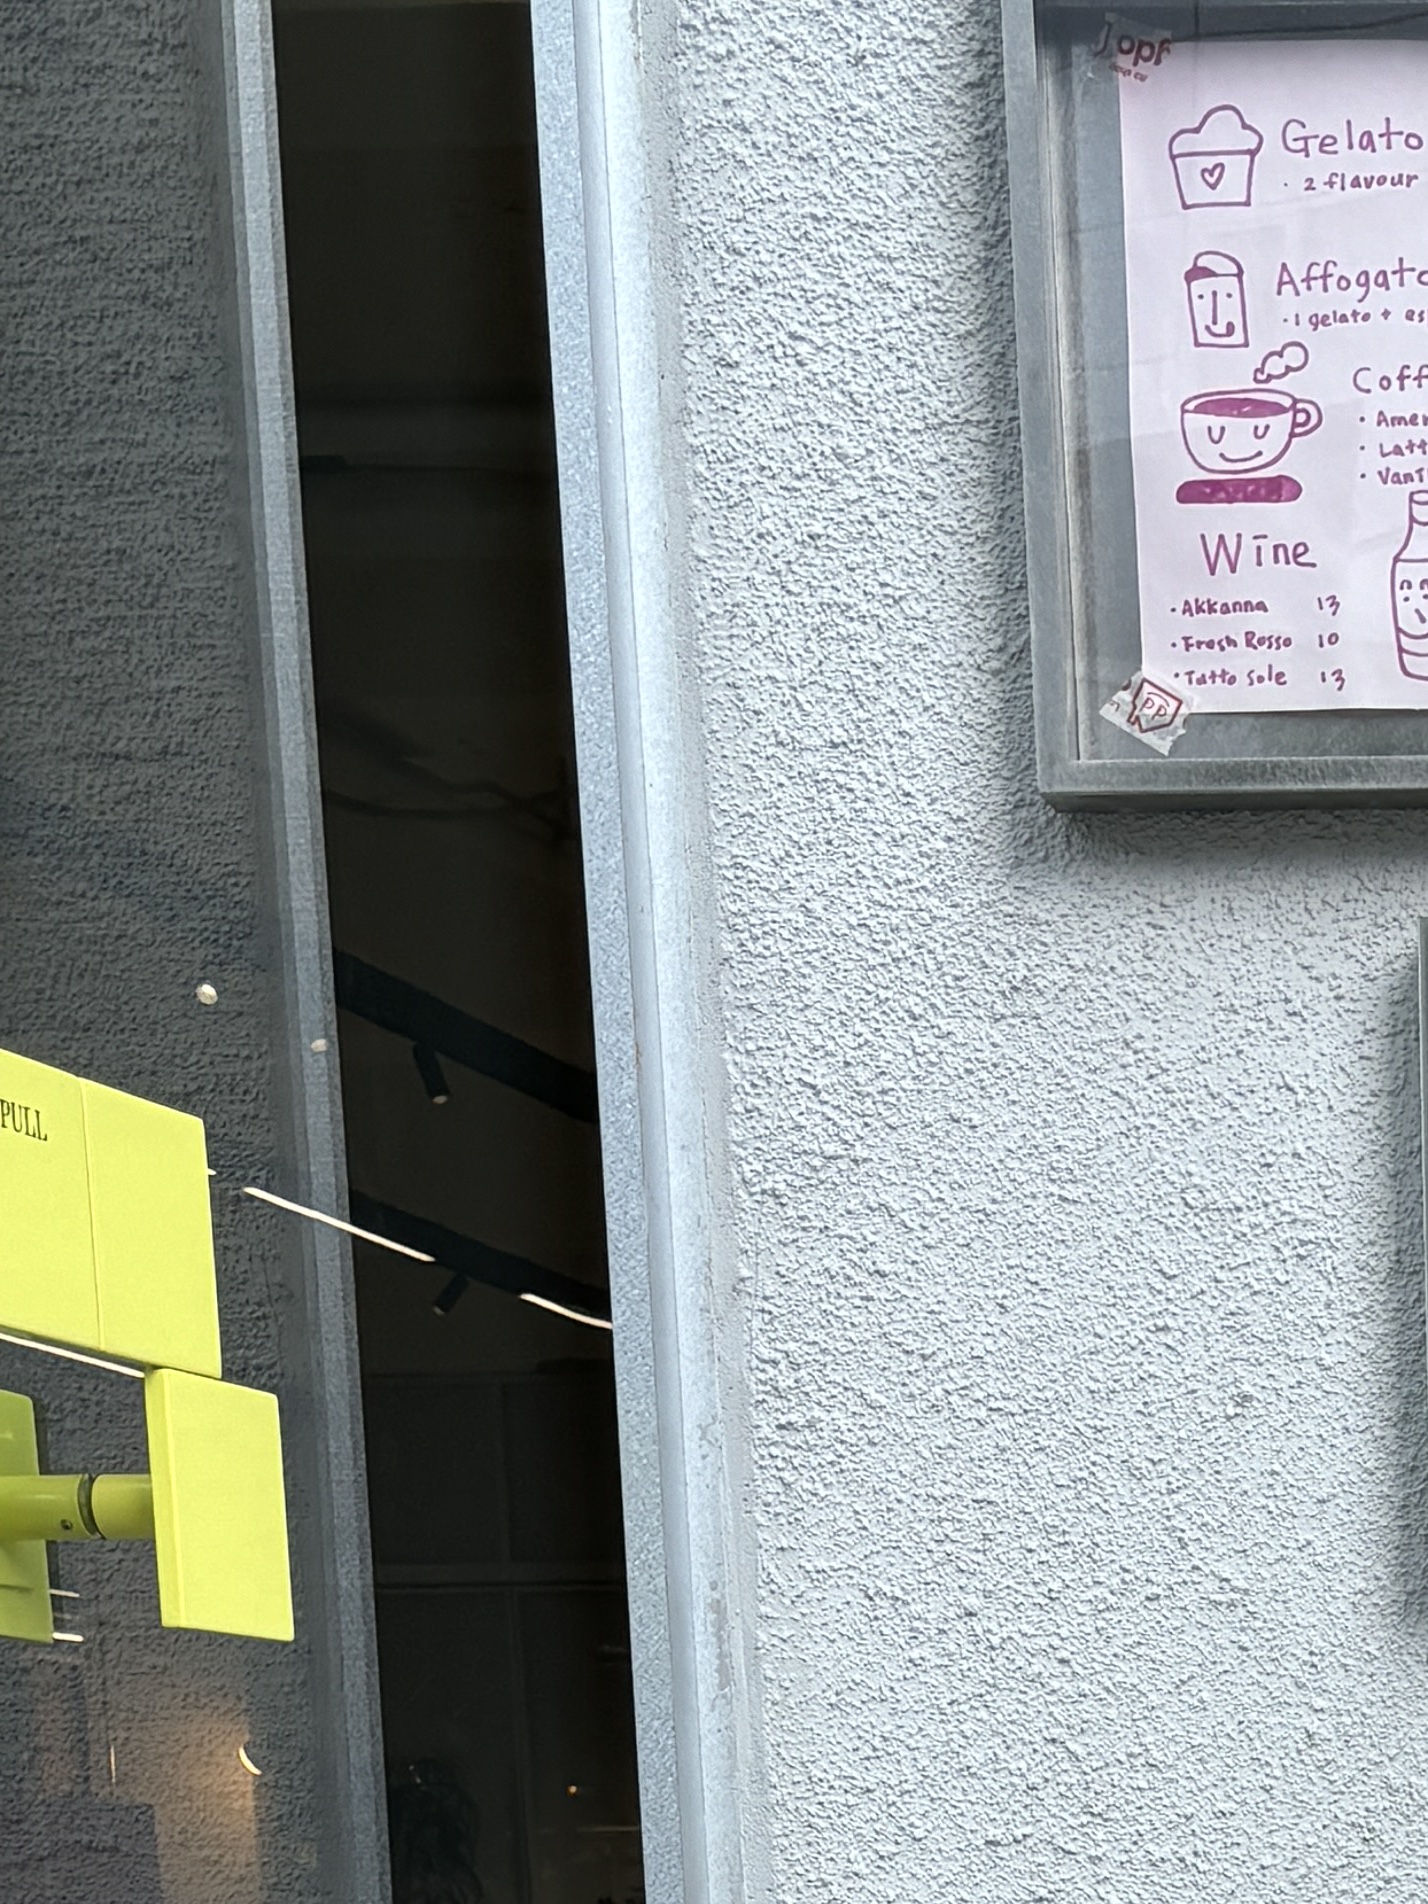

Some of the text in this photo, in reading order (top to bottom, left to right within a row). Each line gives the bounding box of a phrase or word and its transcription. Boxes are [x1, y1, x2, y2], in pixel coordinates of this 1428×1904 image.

[1282, 117, 1424, 157] Gelato
[1303, 172, 1419, 192] 2 flavour
[1294, 312, 1300, 327] 1
[1308, 309, 1371, 331] gelato
[1200, 532, 1318, 577] Wine
[1181, 595, 1341, 617] Akkanna 13
[1244, 630, 1292, 650] Rosso
[1318, 632, 1340, 649] 10
[1320, 668, 1346, 692] 13
[0, 1098, 48, 1142] PULL
